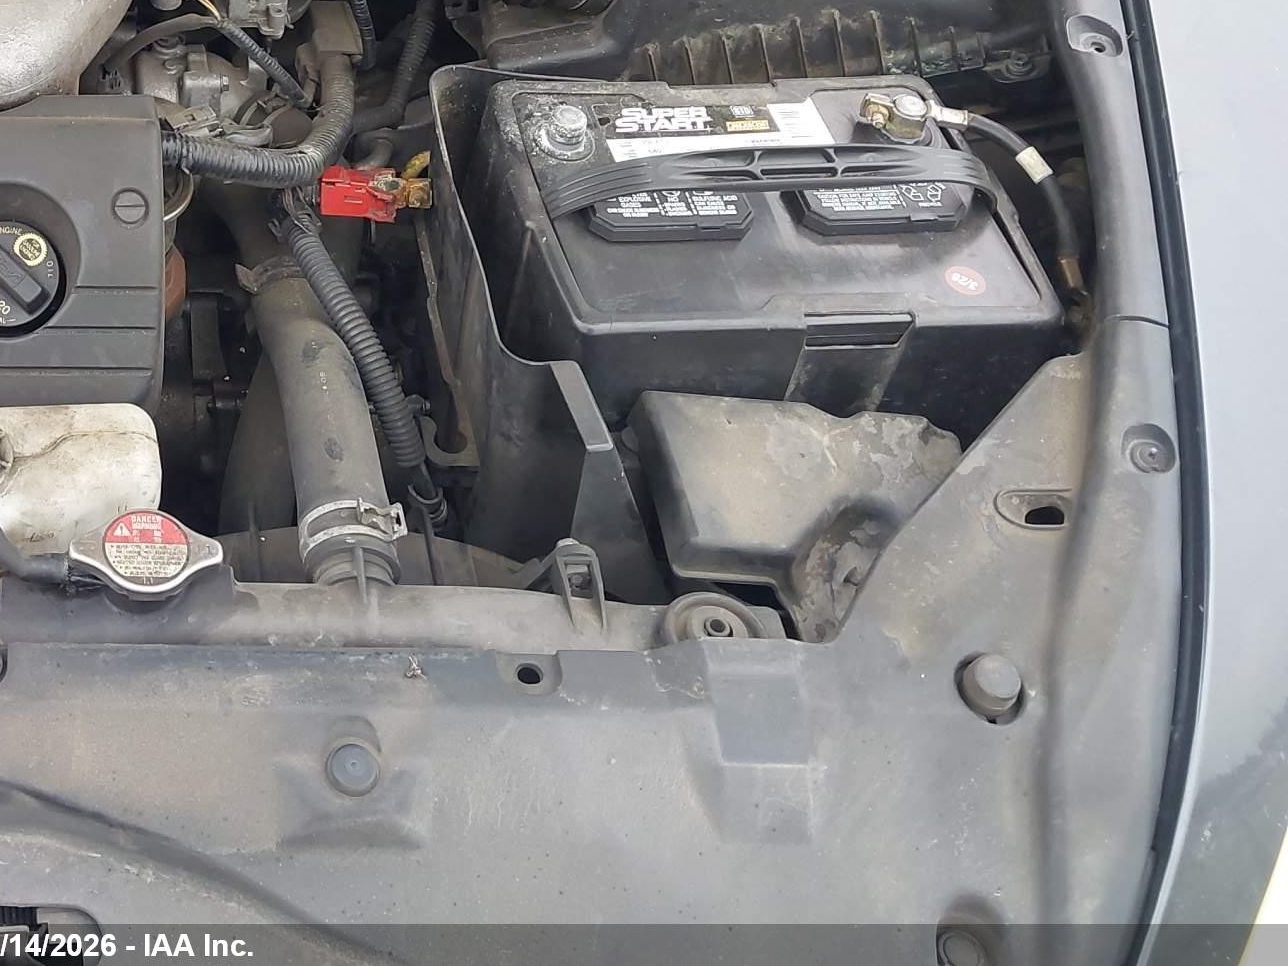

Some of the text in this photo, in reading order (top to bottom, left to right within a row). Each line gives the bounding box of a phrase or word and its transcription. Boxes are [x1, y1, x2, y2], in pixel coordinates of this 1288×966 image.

[621, 107, 708, 119] SUPER
[615, 117, 713, 132] START
[46, 260, 54, 278] OIL
